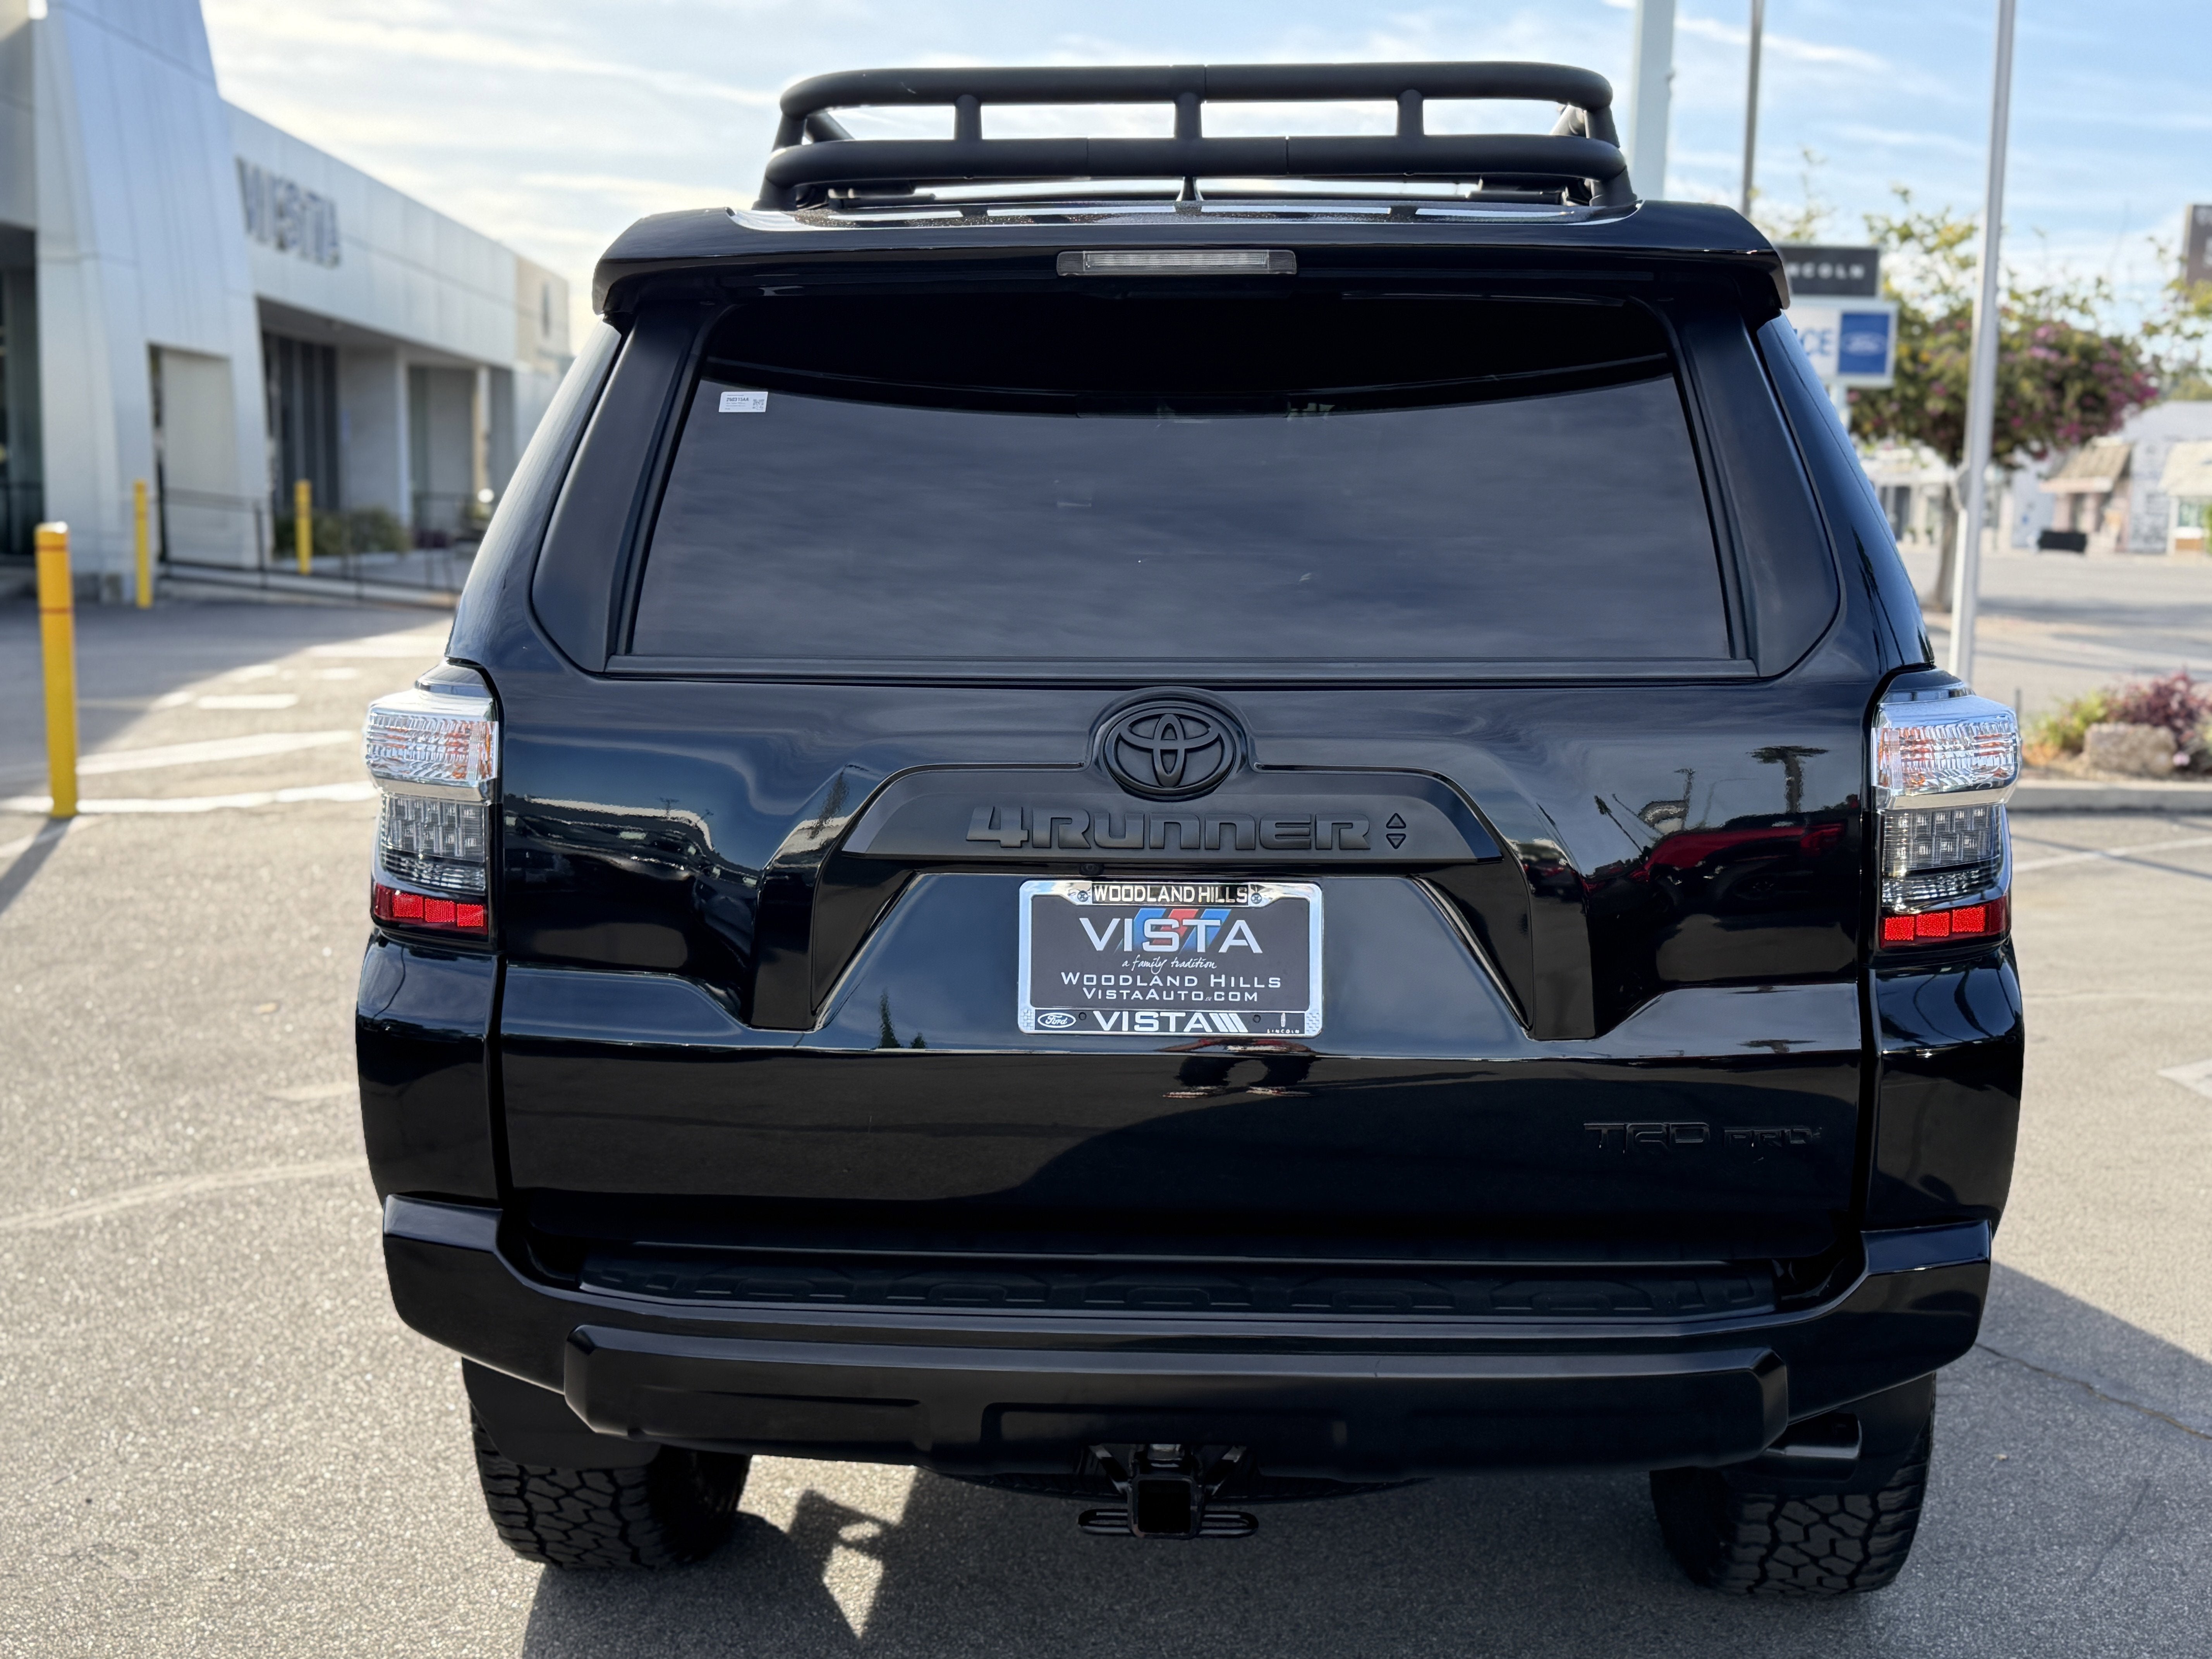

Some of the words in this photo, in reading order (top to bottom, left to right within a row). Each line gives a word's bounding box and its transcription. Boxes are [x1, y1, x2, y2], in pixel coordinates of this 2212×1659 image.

[1094, 885, 1195, 902] WOODLAND
[1198, 886, 1248, 903] HILLS
[1079, 917, 1262, 953] VISTA
[1131, 954, 1168, 975] family
[1171, 957, 1217, 969] tradition
[1045, 1015, 1068, 1025] Ford
[1093, 1011, 1212, 1032] VISTA
[1583, 1121, 1710, 1153] TRD
